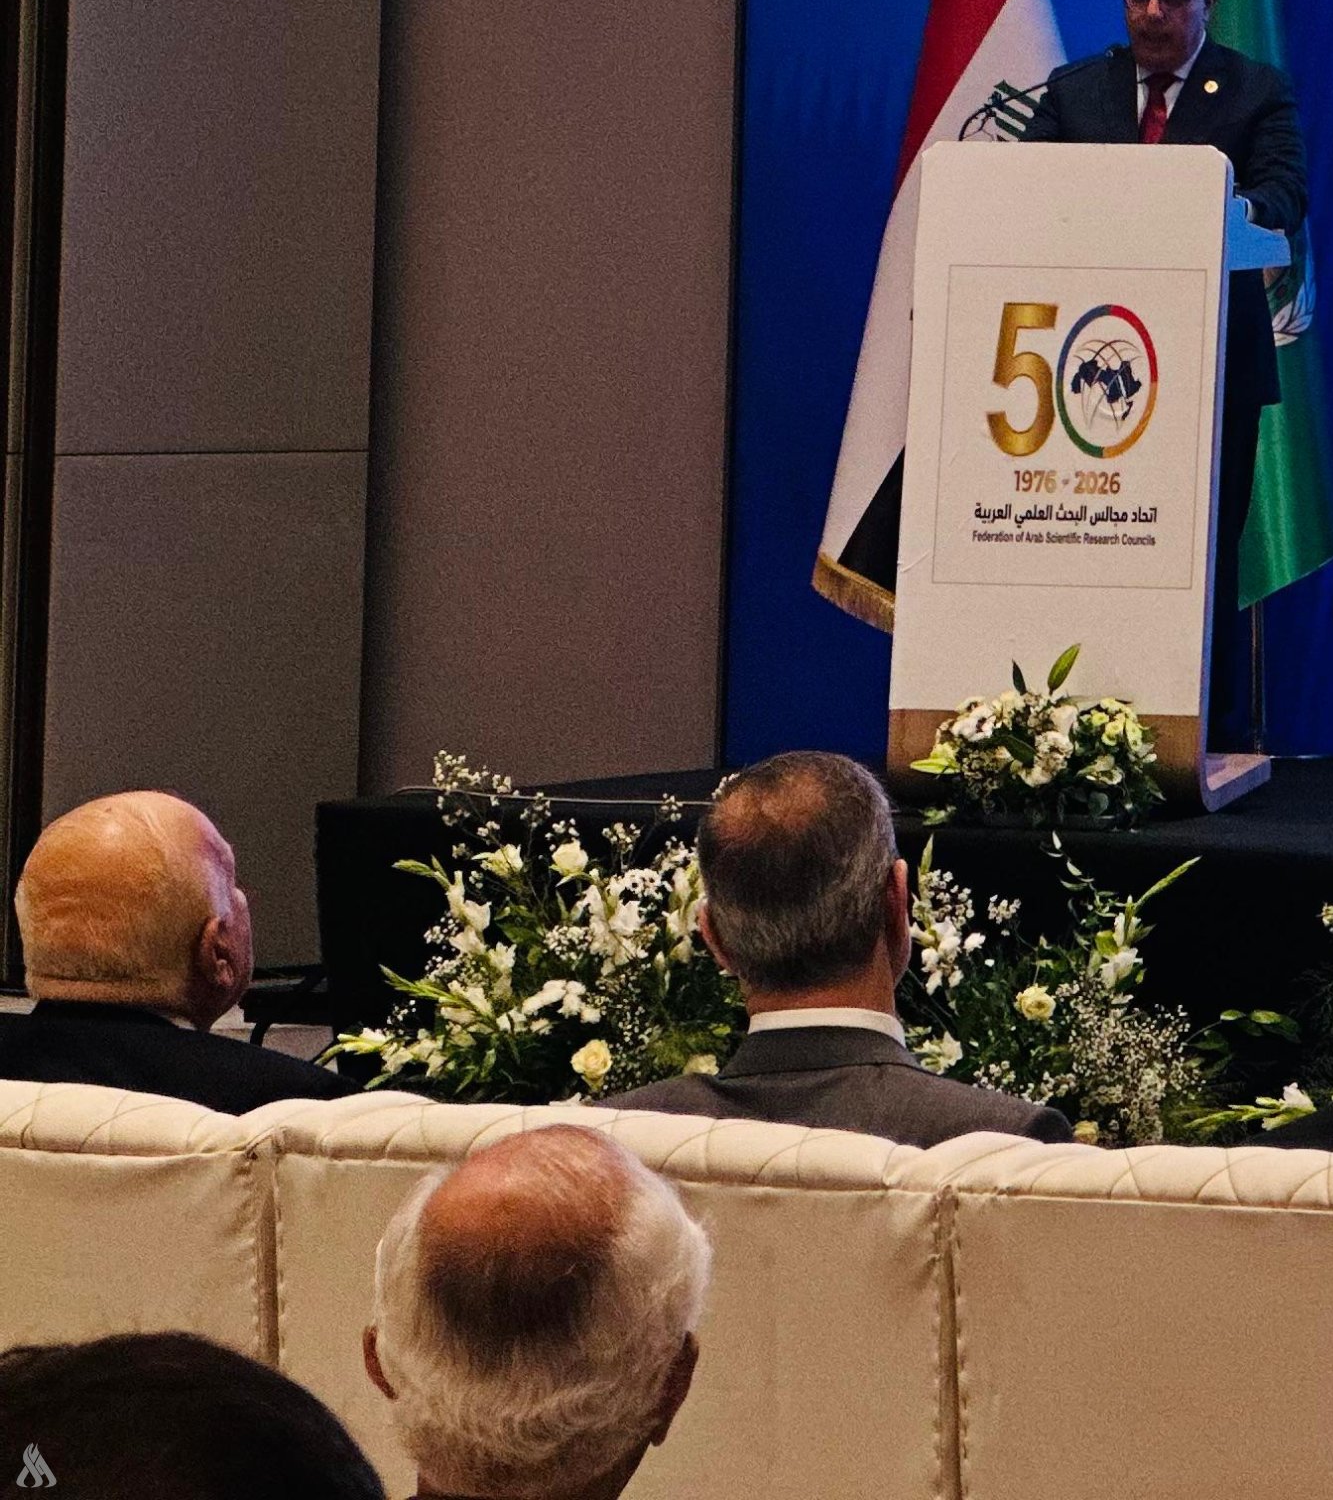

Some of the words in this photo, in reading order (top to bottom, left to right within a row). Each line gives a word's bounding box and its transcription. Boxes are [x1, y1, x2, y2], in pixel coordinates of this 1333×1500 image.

[986, 301, 1158, 459] 50
[1014, 469, 1057, 494] 1976
[1073, 470, 1121, 495] 2026
[974, 502, 1012, 524] العربية
[1014, 503, 1053, 529] العلمي
[1055, 502, 1087, 527] البحث
[1089, 505, 1128, 528] مجالس
[1131, 505, 1158, 523] اتحاد
[972, 530, 1014, 543] Federation
[1015, 531, 1024, 543] of
[1025, 531, 1044, 544] Arab
[1045, 532, 1082, 545] Scientific
[1083, 532, 1120, 545] Research
[1121, 533, 1157, 547] Councils
